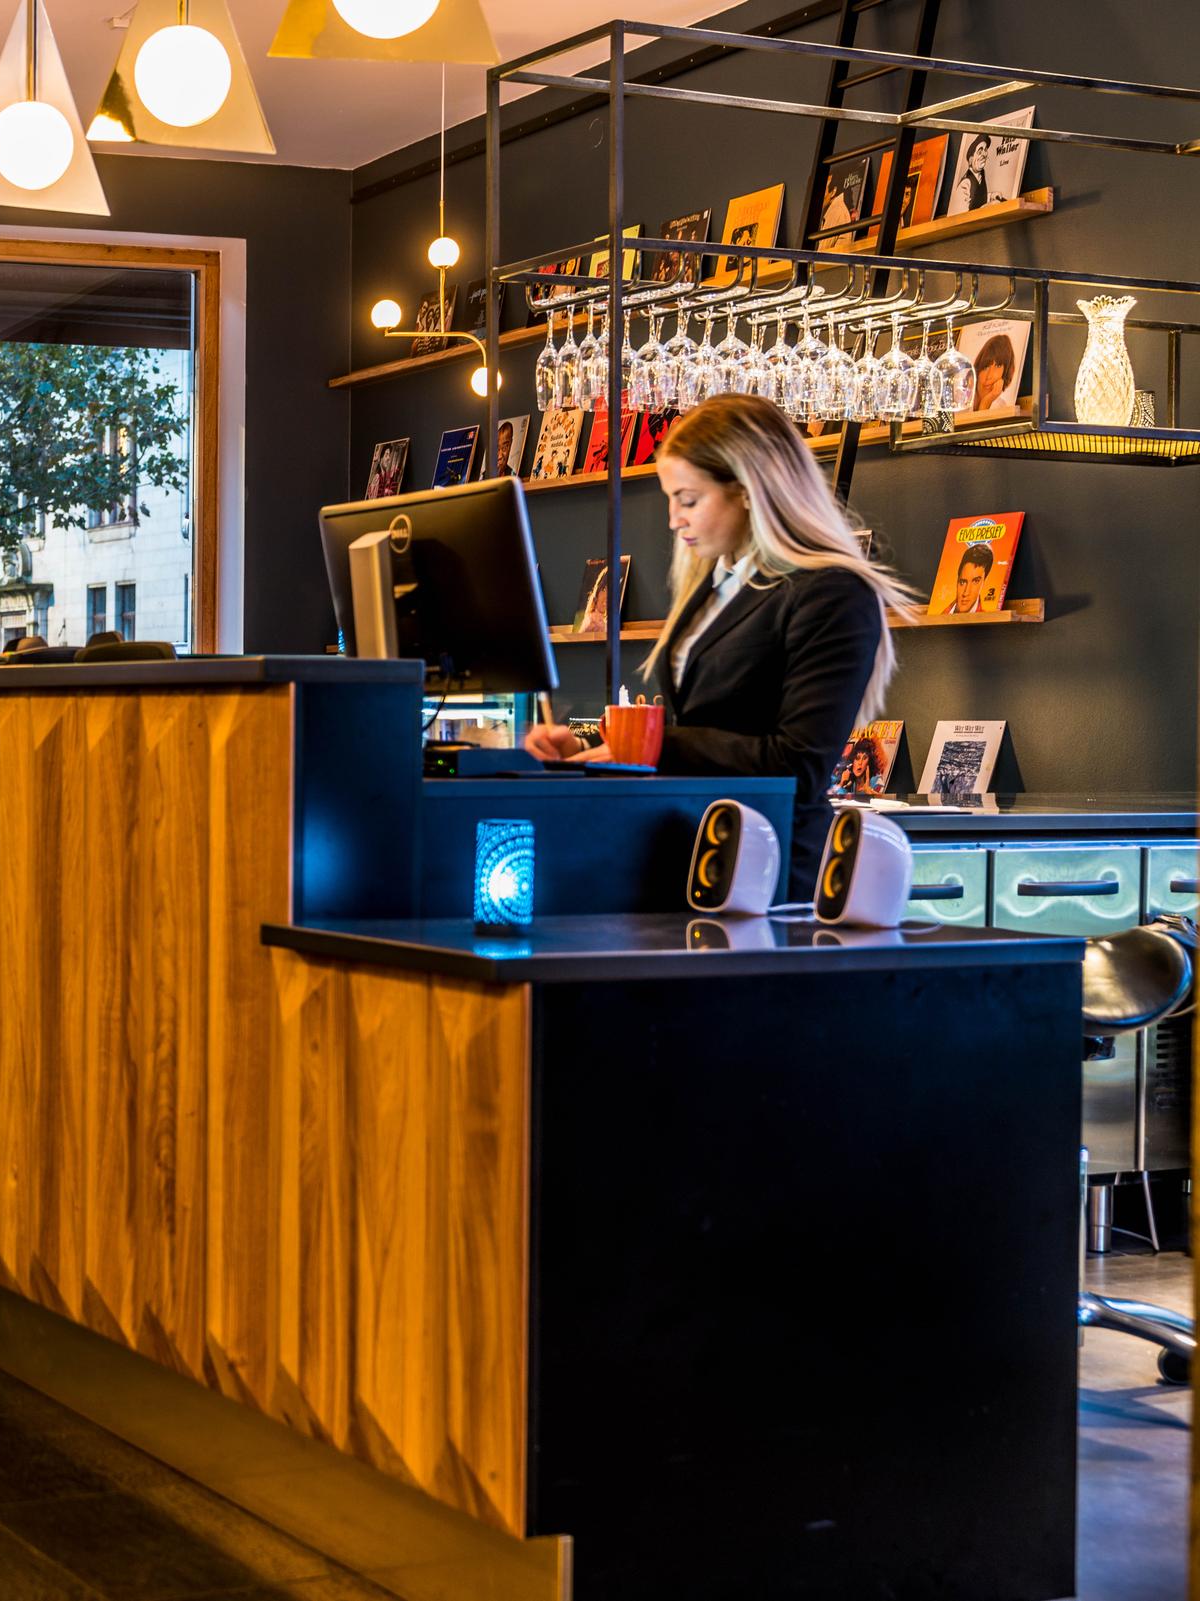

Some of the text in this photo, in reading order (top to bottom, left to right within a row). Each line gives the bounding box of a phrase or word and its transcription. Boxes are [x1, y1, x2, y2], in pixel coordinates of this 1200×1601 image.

[996, 143, 1019, 156] Waller
[959, 525, 1004, 541] ELVIS PRESLEY
